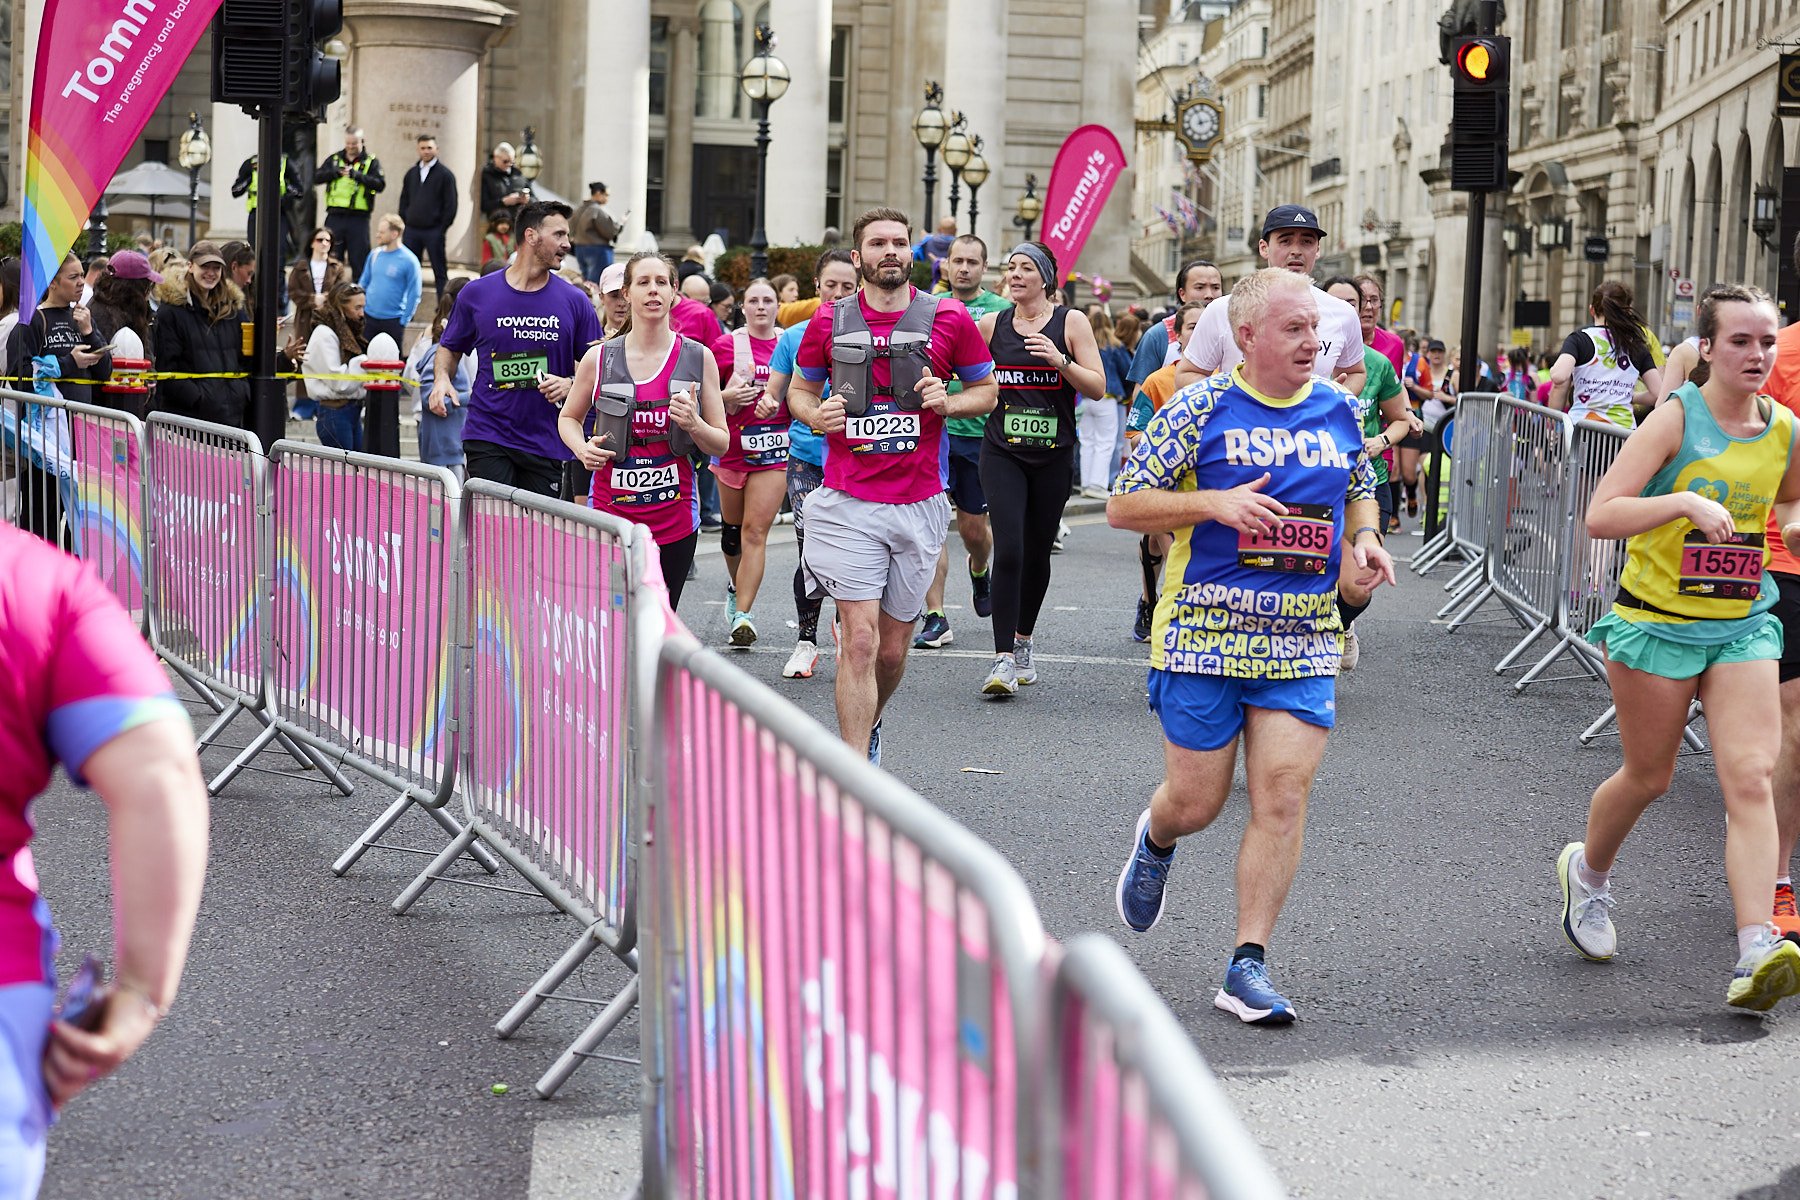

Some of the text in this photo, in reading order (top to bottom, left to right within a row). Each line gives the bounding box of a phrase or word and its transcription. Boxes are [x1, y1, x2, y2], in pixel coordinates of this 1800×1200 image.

[103, 103, 123, 124] The
[120, 45, 163, 104] pregnancy
[157, 19, 176, 44] and
[1050, 149, 1105, 240] Tommy's
[497, 315, 560, 329] rowcroft
[43, 332, 66, 348] Jack
[513, 328, 559, 341] hospice
[501, 361, 539, 377] 8397
[995, 370, 1058, 384] WAR child
[852, 416, 915, 436] 10223
[1011, 418, 1050, 434] 6103
[749, 434, 783, 448] 9130
[617, 467, 675, 488] 10224
[1734, 482, 1751, 491] THE
[1691, 550, 1761, 576] 15575
[1186, 583, 1333, 618] RSPCA RSPCA
[1229, 611, 1295, 633] RSPCA
[1176, 627, 1326, 659] RSPCA RSPCA
[1222, 656, 1293, 680] RSPCA
